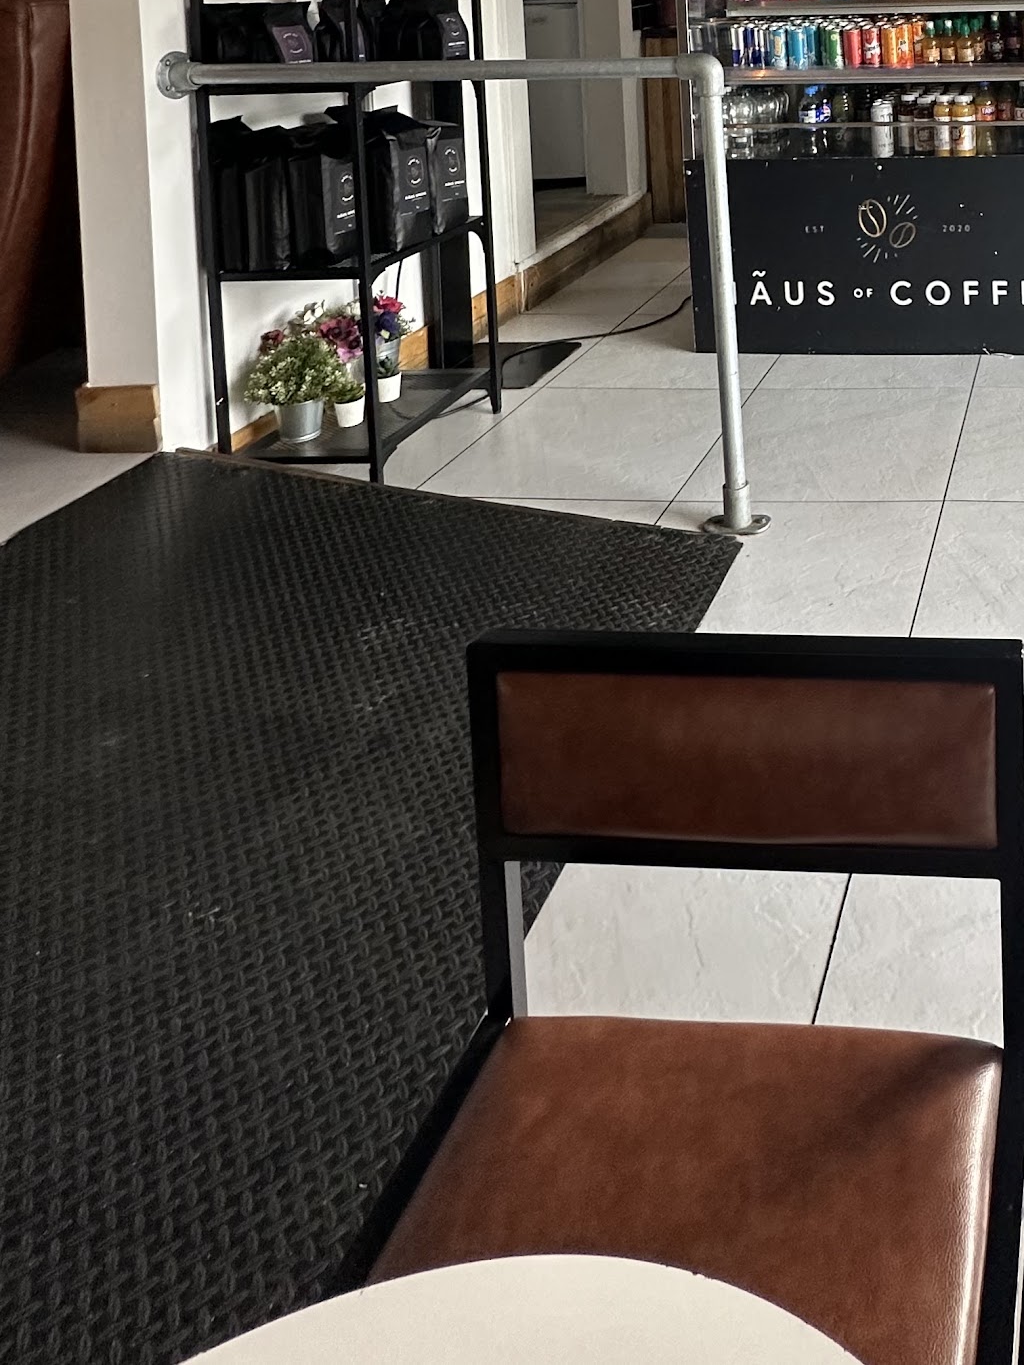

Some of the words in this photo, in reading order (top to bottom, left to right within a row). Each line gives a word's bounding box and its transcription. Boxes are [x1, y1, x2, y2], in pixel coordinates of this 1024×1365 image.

[805, 225, 825, 233] EST
[942, 224, 971, 233] 2020
[733, 270, 836, 306] ÃUS
[853, 288, 874, 299] OF
